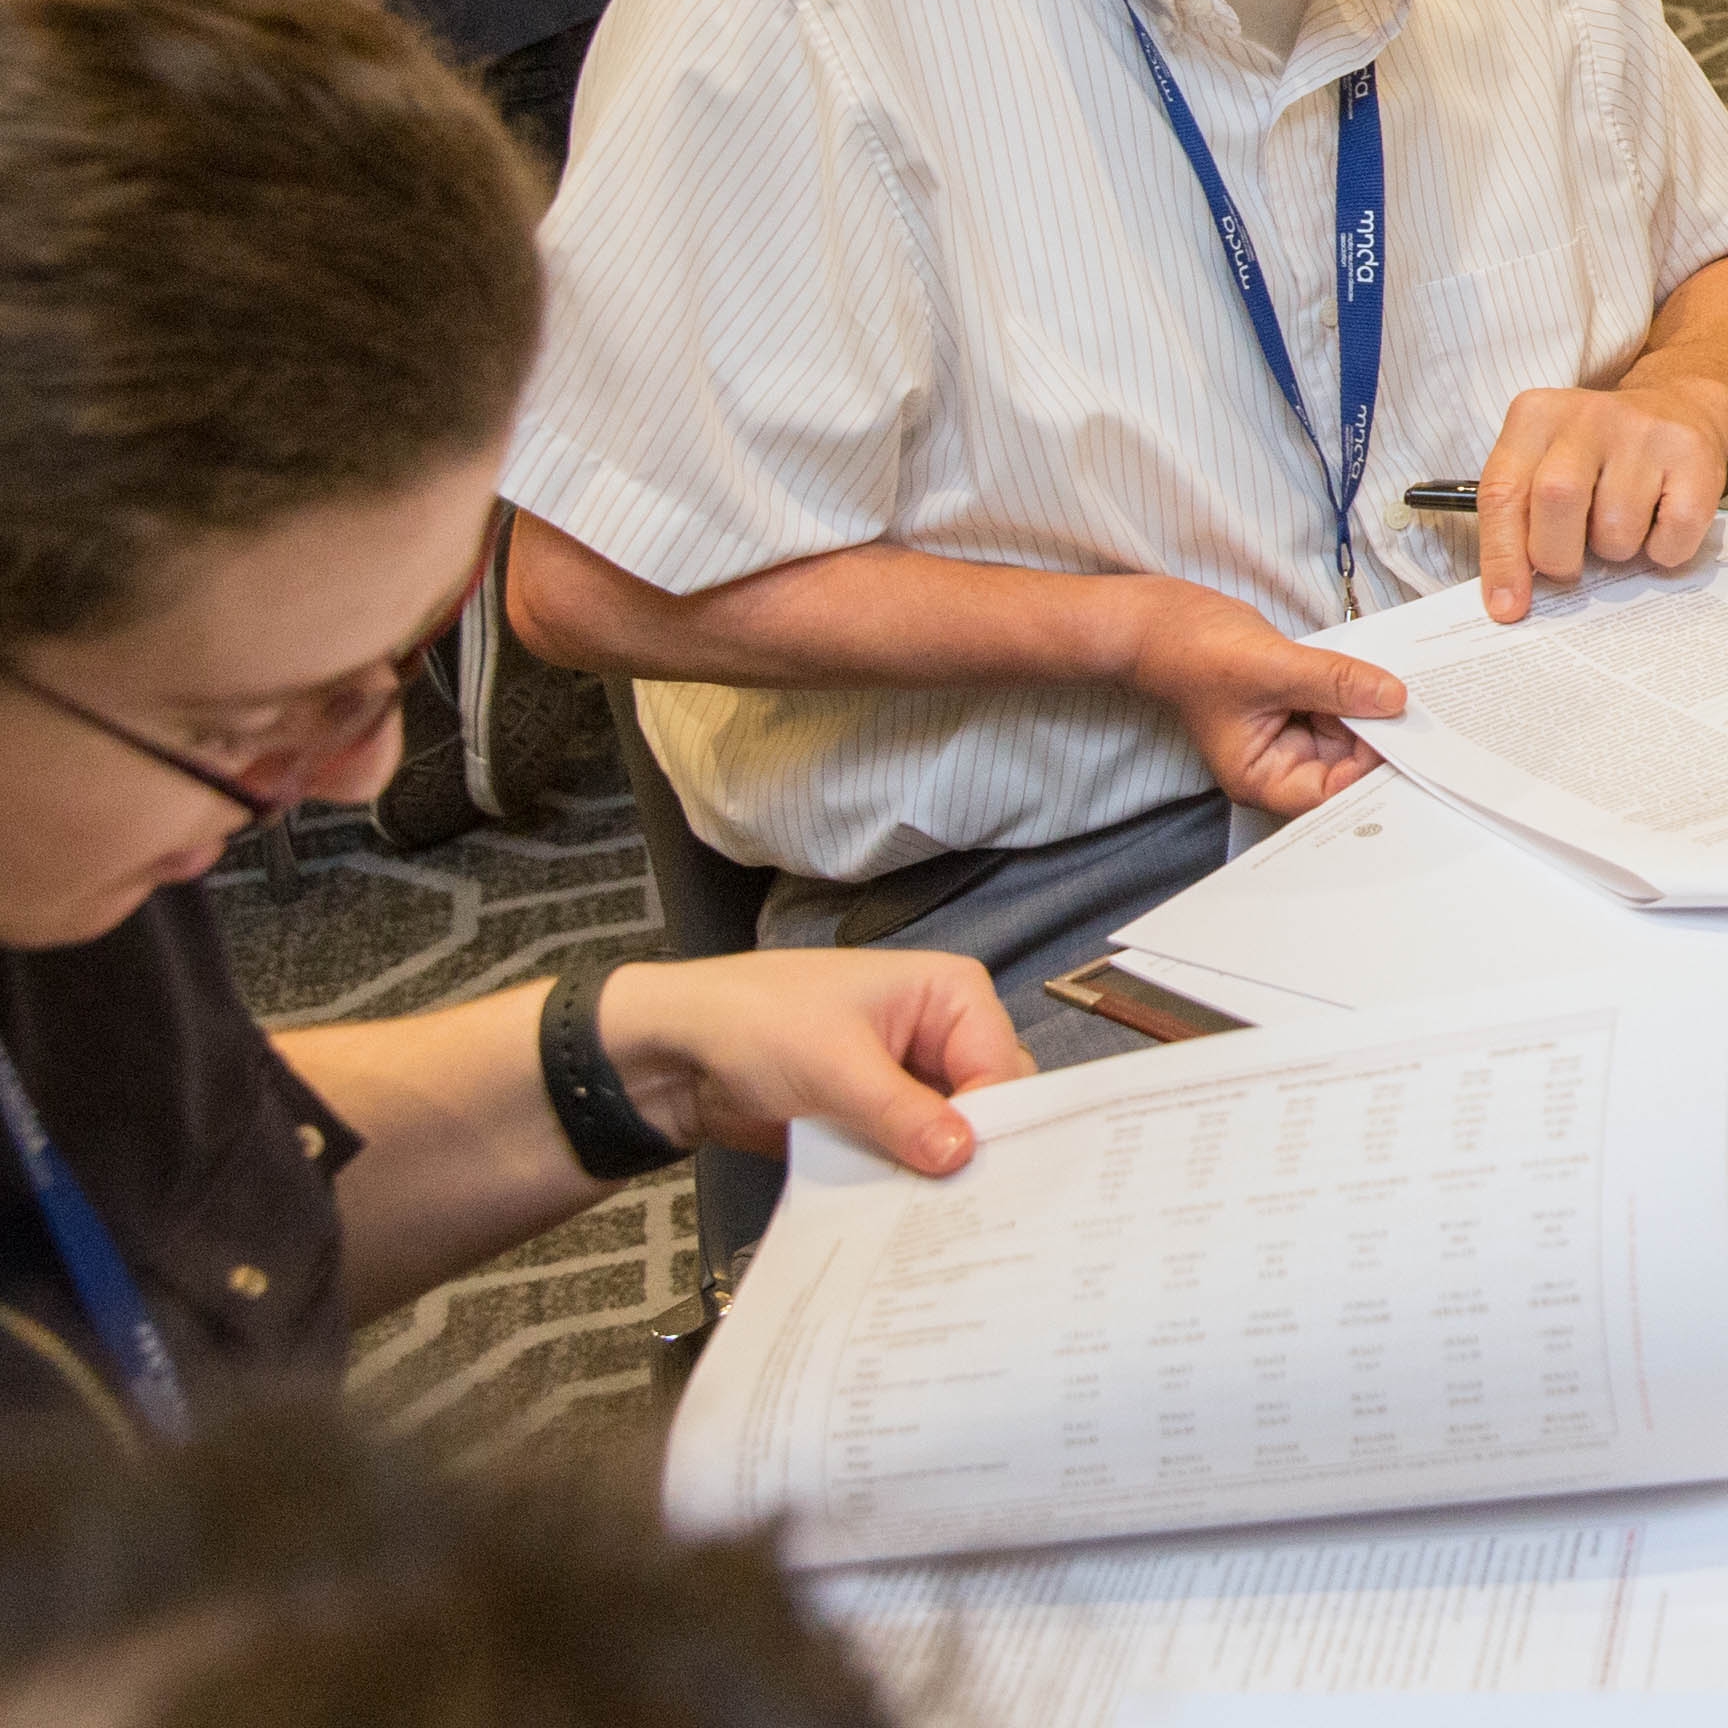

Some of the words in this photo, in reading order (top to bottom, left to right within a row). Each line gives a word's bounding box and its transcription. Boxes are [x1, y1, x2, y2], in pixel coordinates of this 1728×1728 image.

[1221, 215, 1250, 292] mnda
[1356, 209, 1375, 283] mnda
[1350, 403, 1367, 480] mnda
